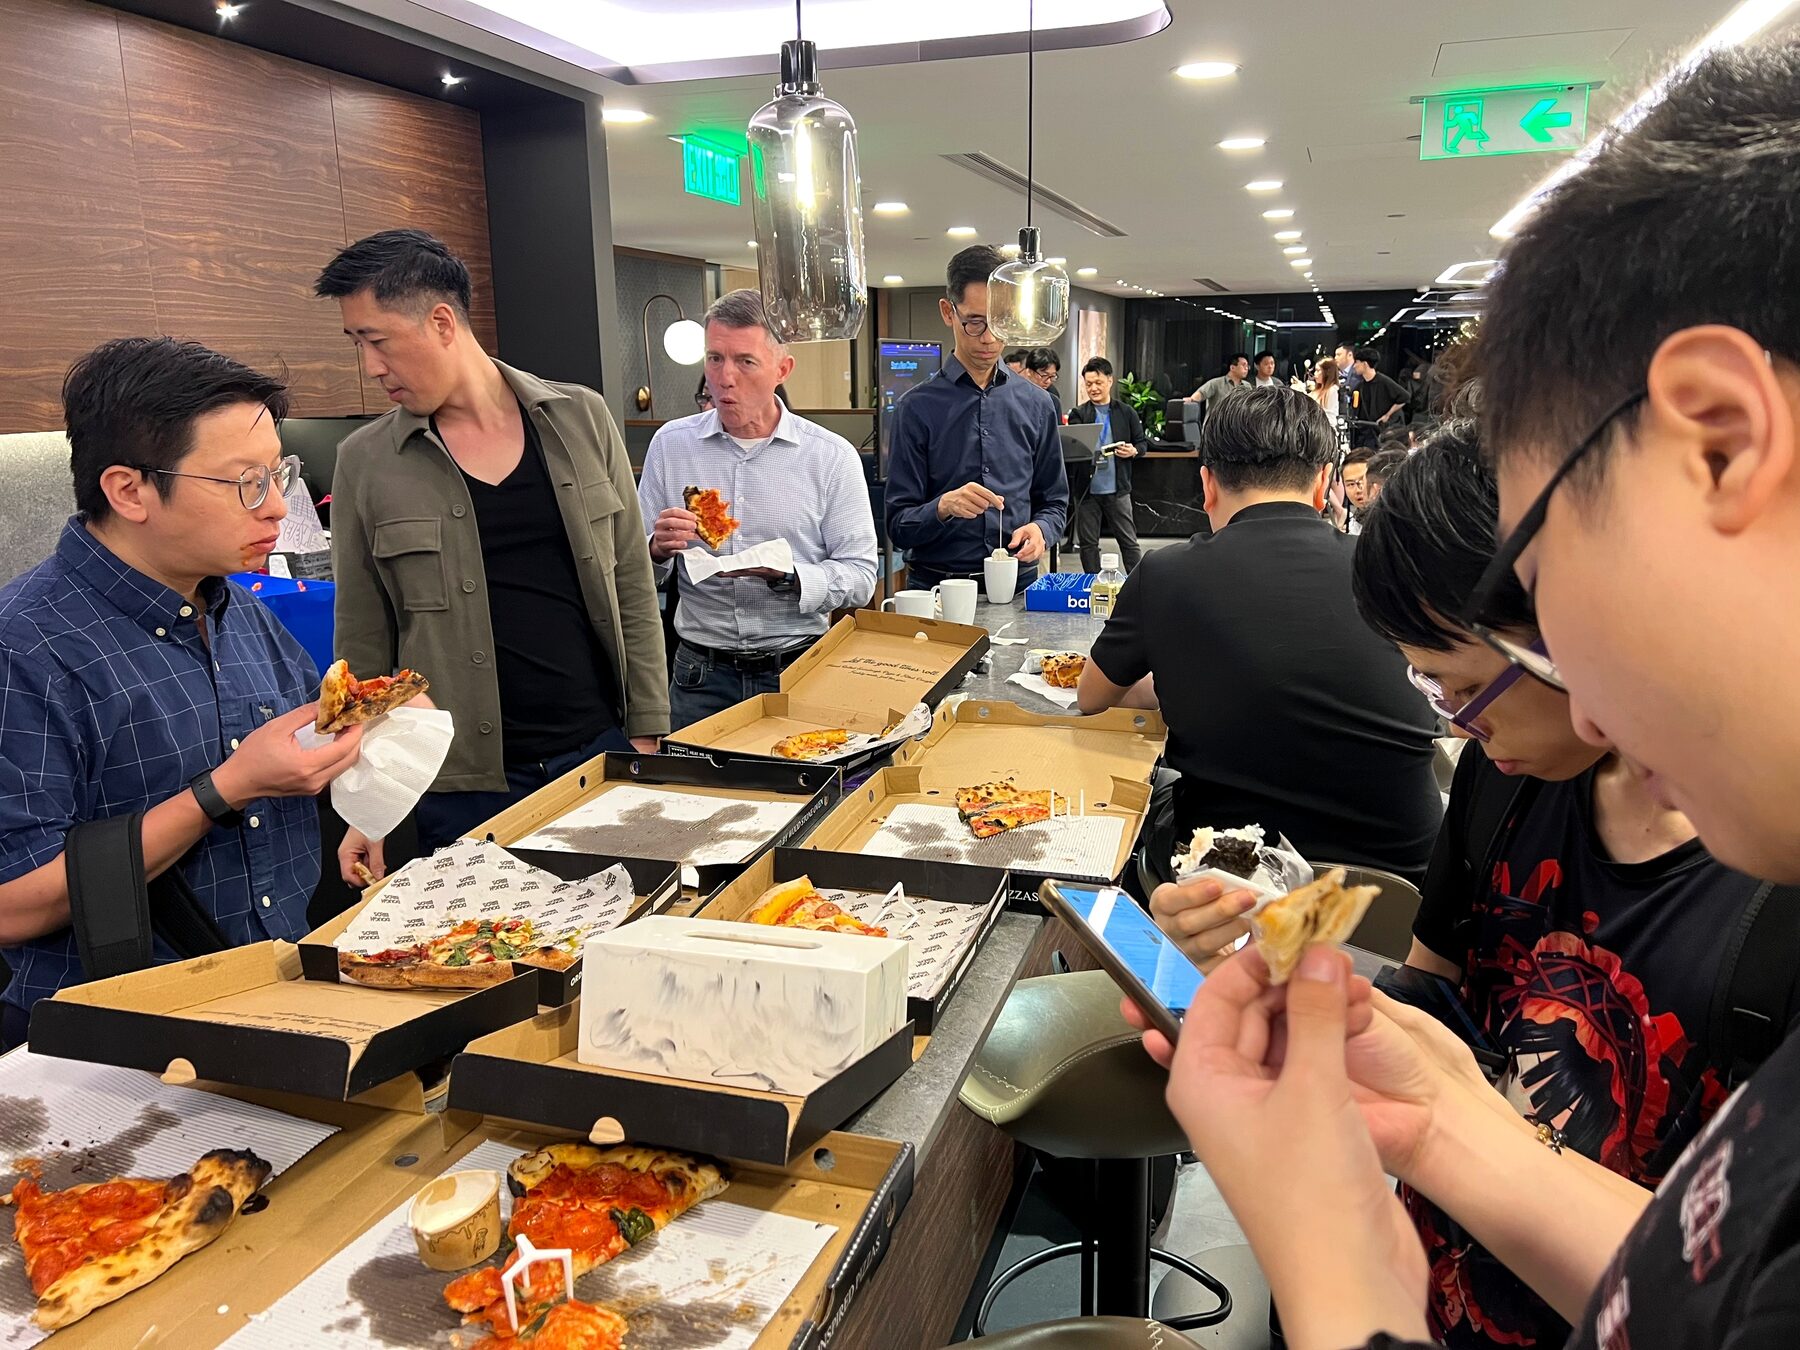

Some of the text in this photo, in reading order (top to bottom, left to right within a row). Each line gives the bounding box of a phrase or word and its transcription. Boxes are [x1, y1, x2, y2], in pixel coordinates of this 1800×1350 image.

[466, 859, 485, 867] DOUGH
[424, 883, 444, 892] DOUGH
[456, 880, 476, 888] DOUGH
[447, 903, 466, 911] DOUGH
